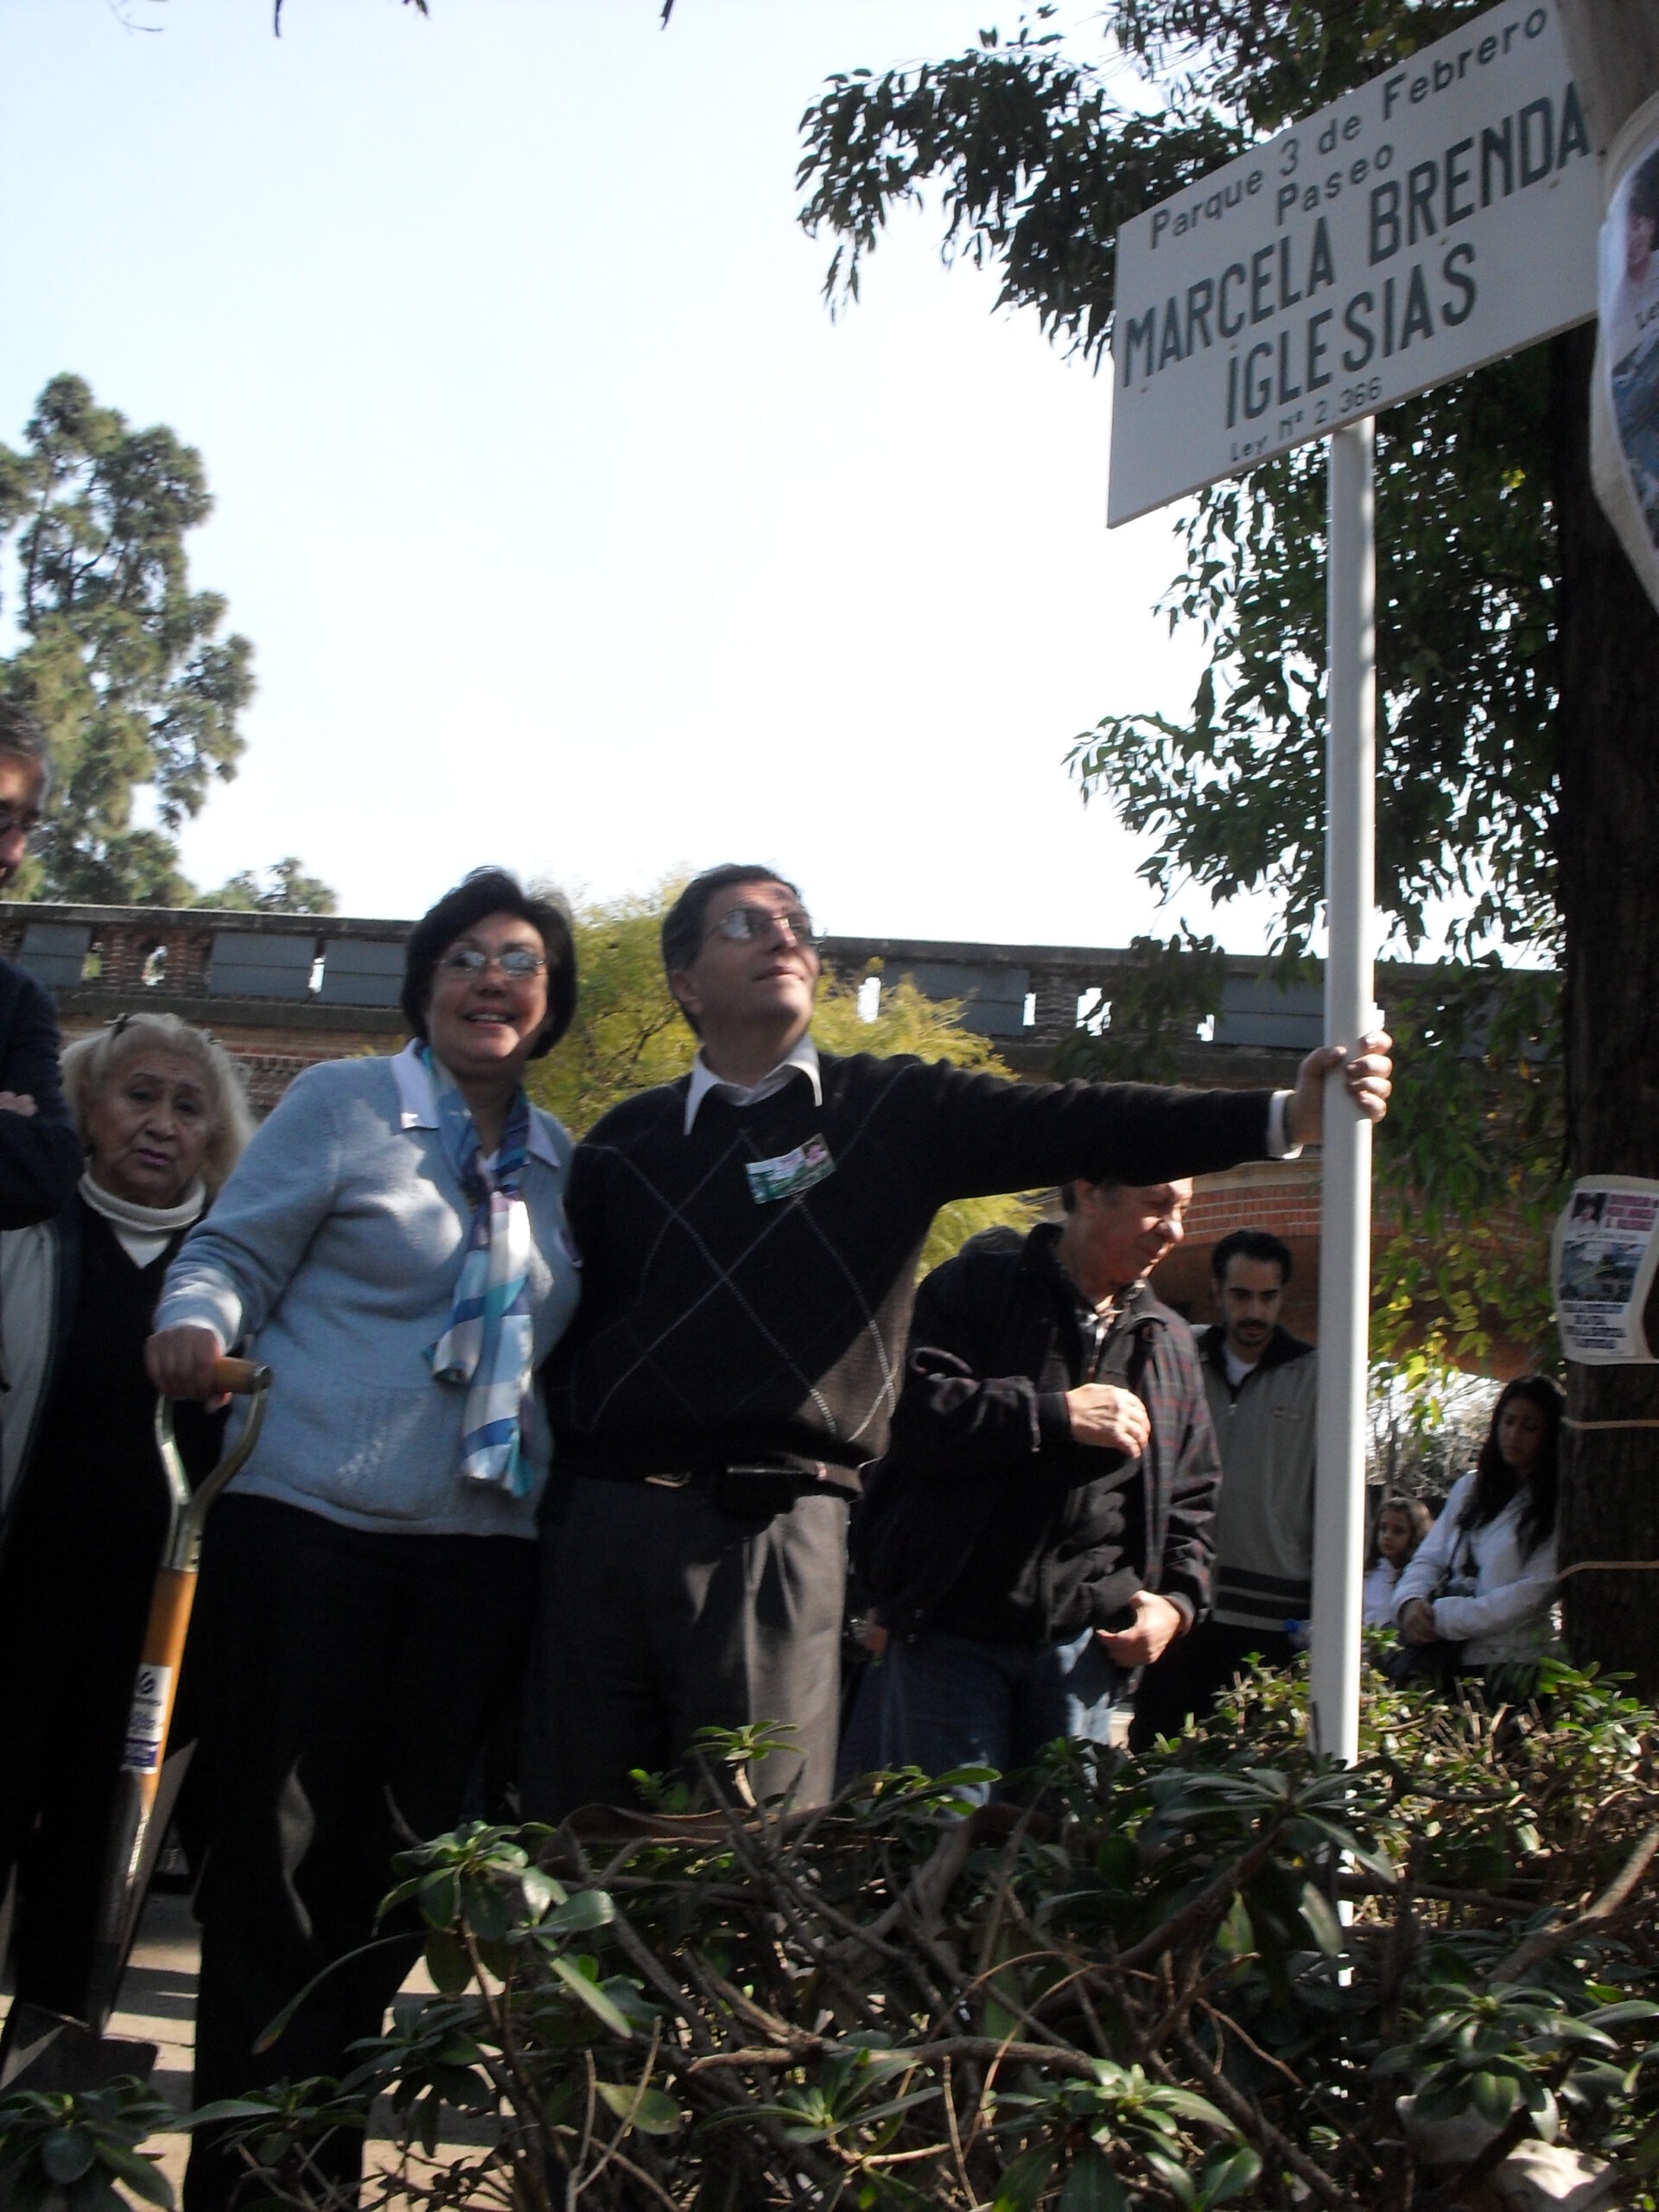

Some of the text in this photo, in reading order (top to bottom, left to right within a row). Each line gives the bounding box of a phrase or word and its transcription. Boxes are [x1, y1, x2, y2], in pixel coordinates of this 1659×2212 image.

[1150, 8, 1548, 250] Parque 3 de Febrero
[1275, 143, 1395, 227] Paseo
[1123, 80, 1590, 388] MARCELA BRENDA
[1224, 241, 1478, 429] IGLESIAS
[1230, 435, 1269, 462] Ley
